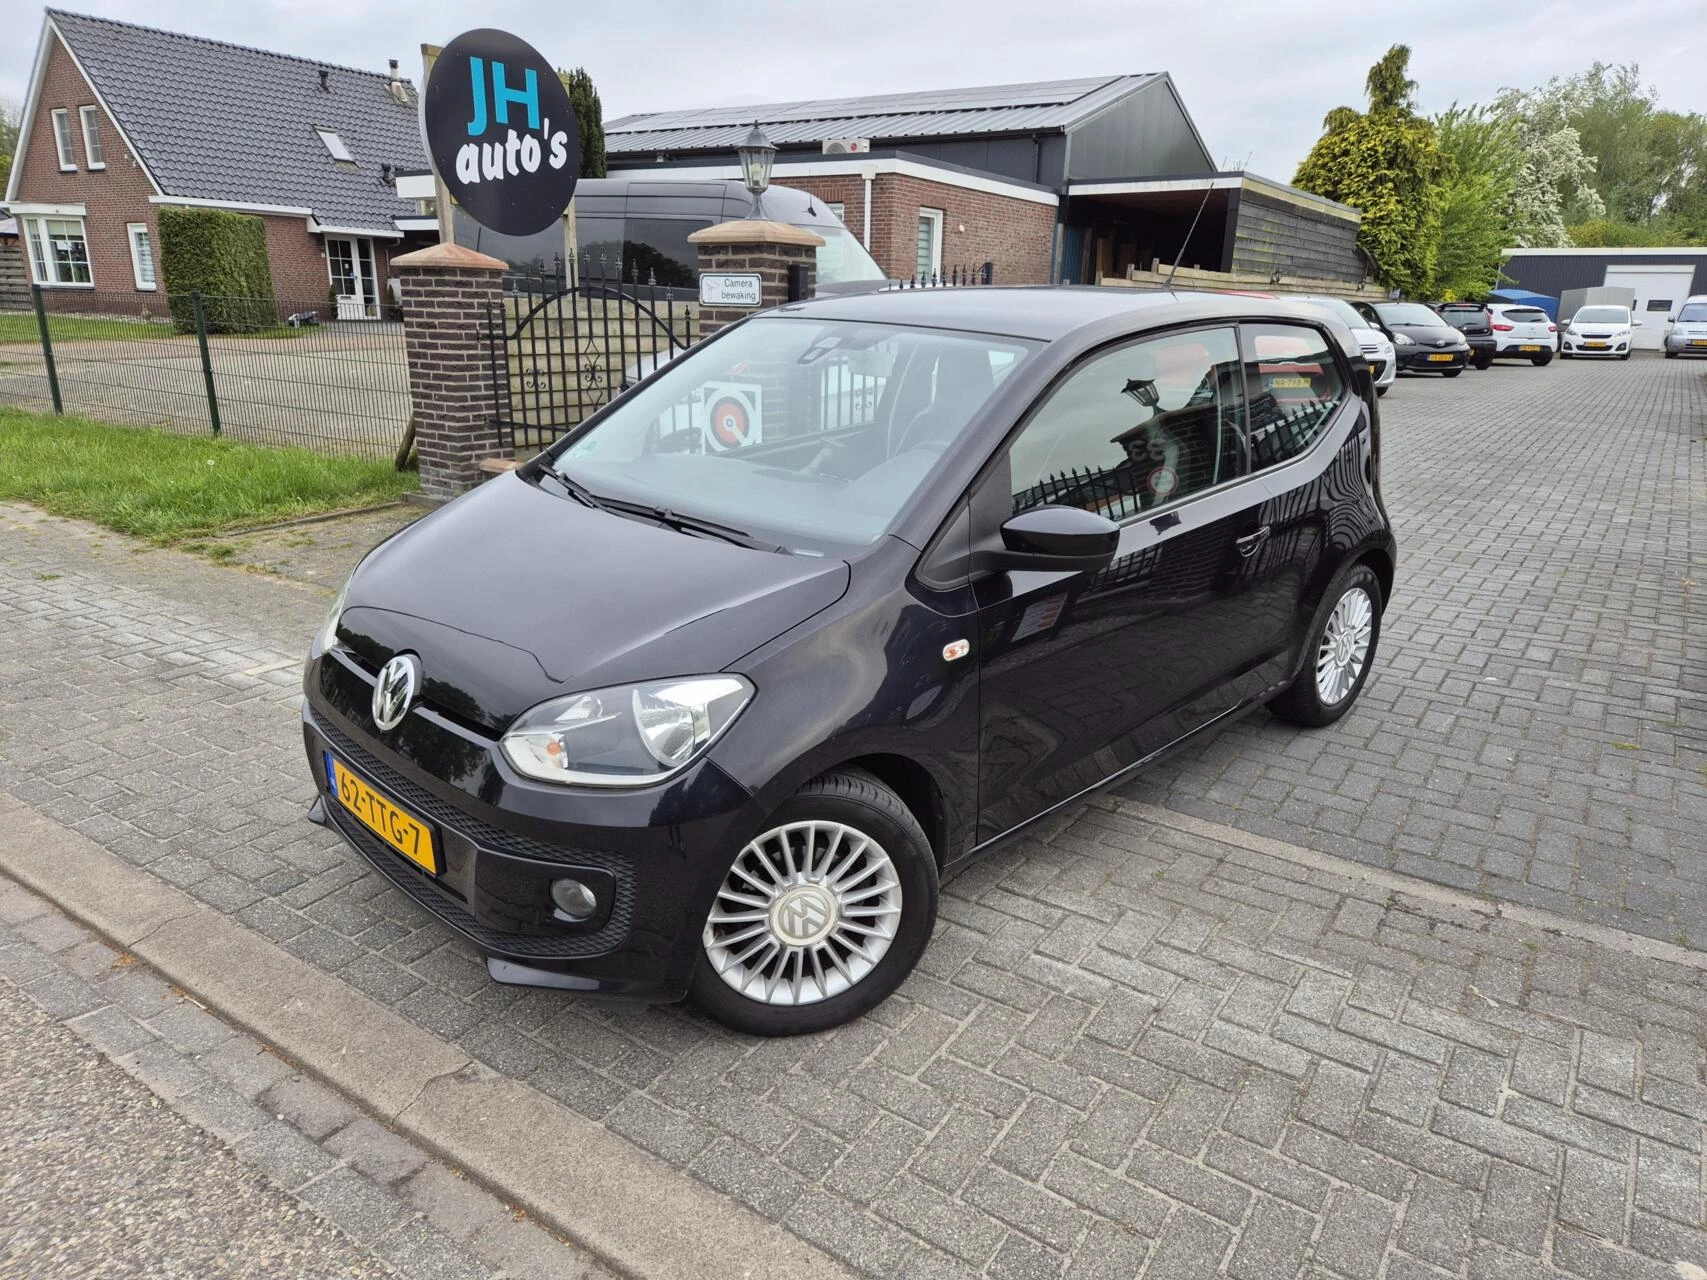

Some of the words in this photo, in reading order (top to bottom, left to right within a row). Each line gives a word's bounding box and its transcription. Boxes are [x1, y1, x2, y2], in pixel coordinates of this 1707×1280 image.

[467, 56, 540, 136] JH
[455, 118, 568, 184] auto's
[721, 290, 756, 302] bewaking
[724, 278, 753, 288] Camera
[341, 772, 420, 856] 62-TTG-7
